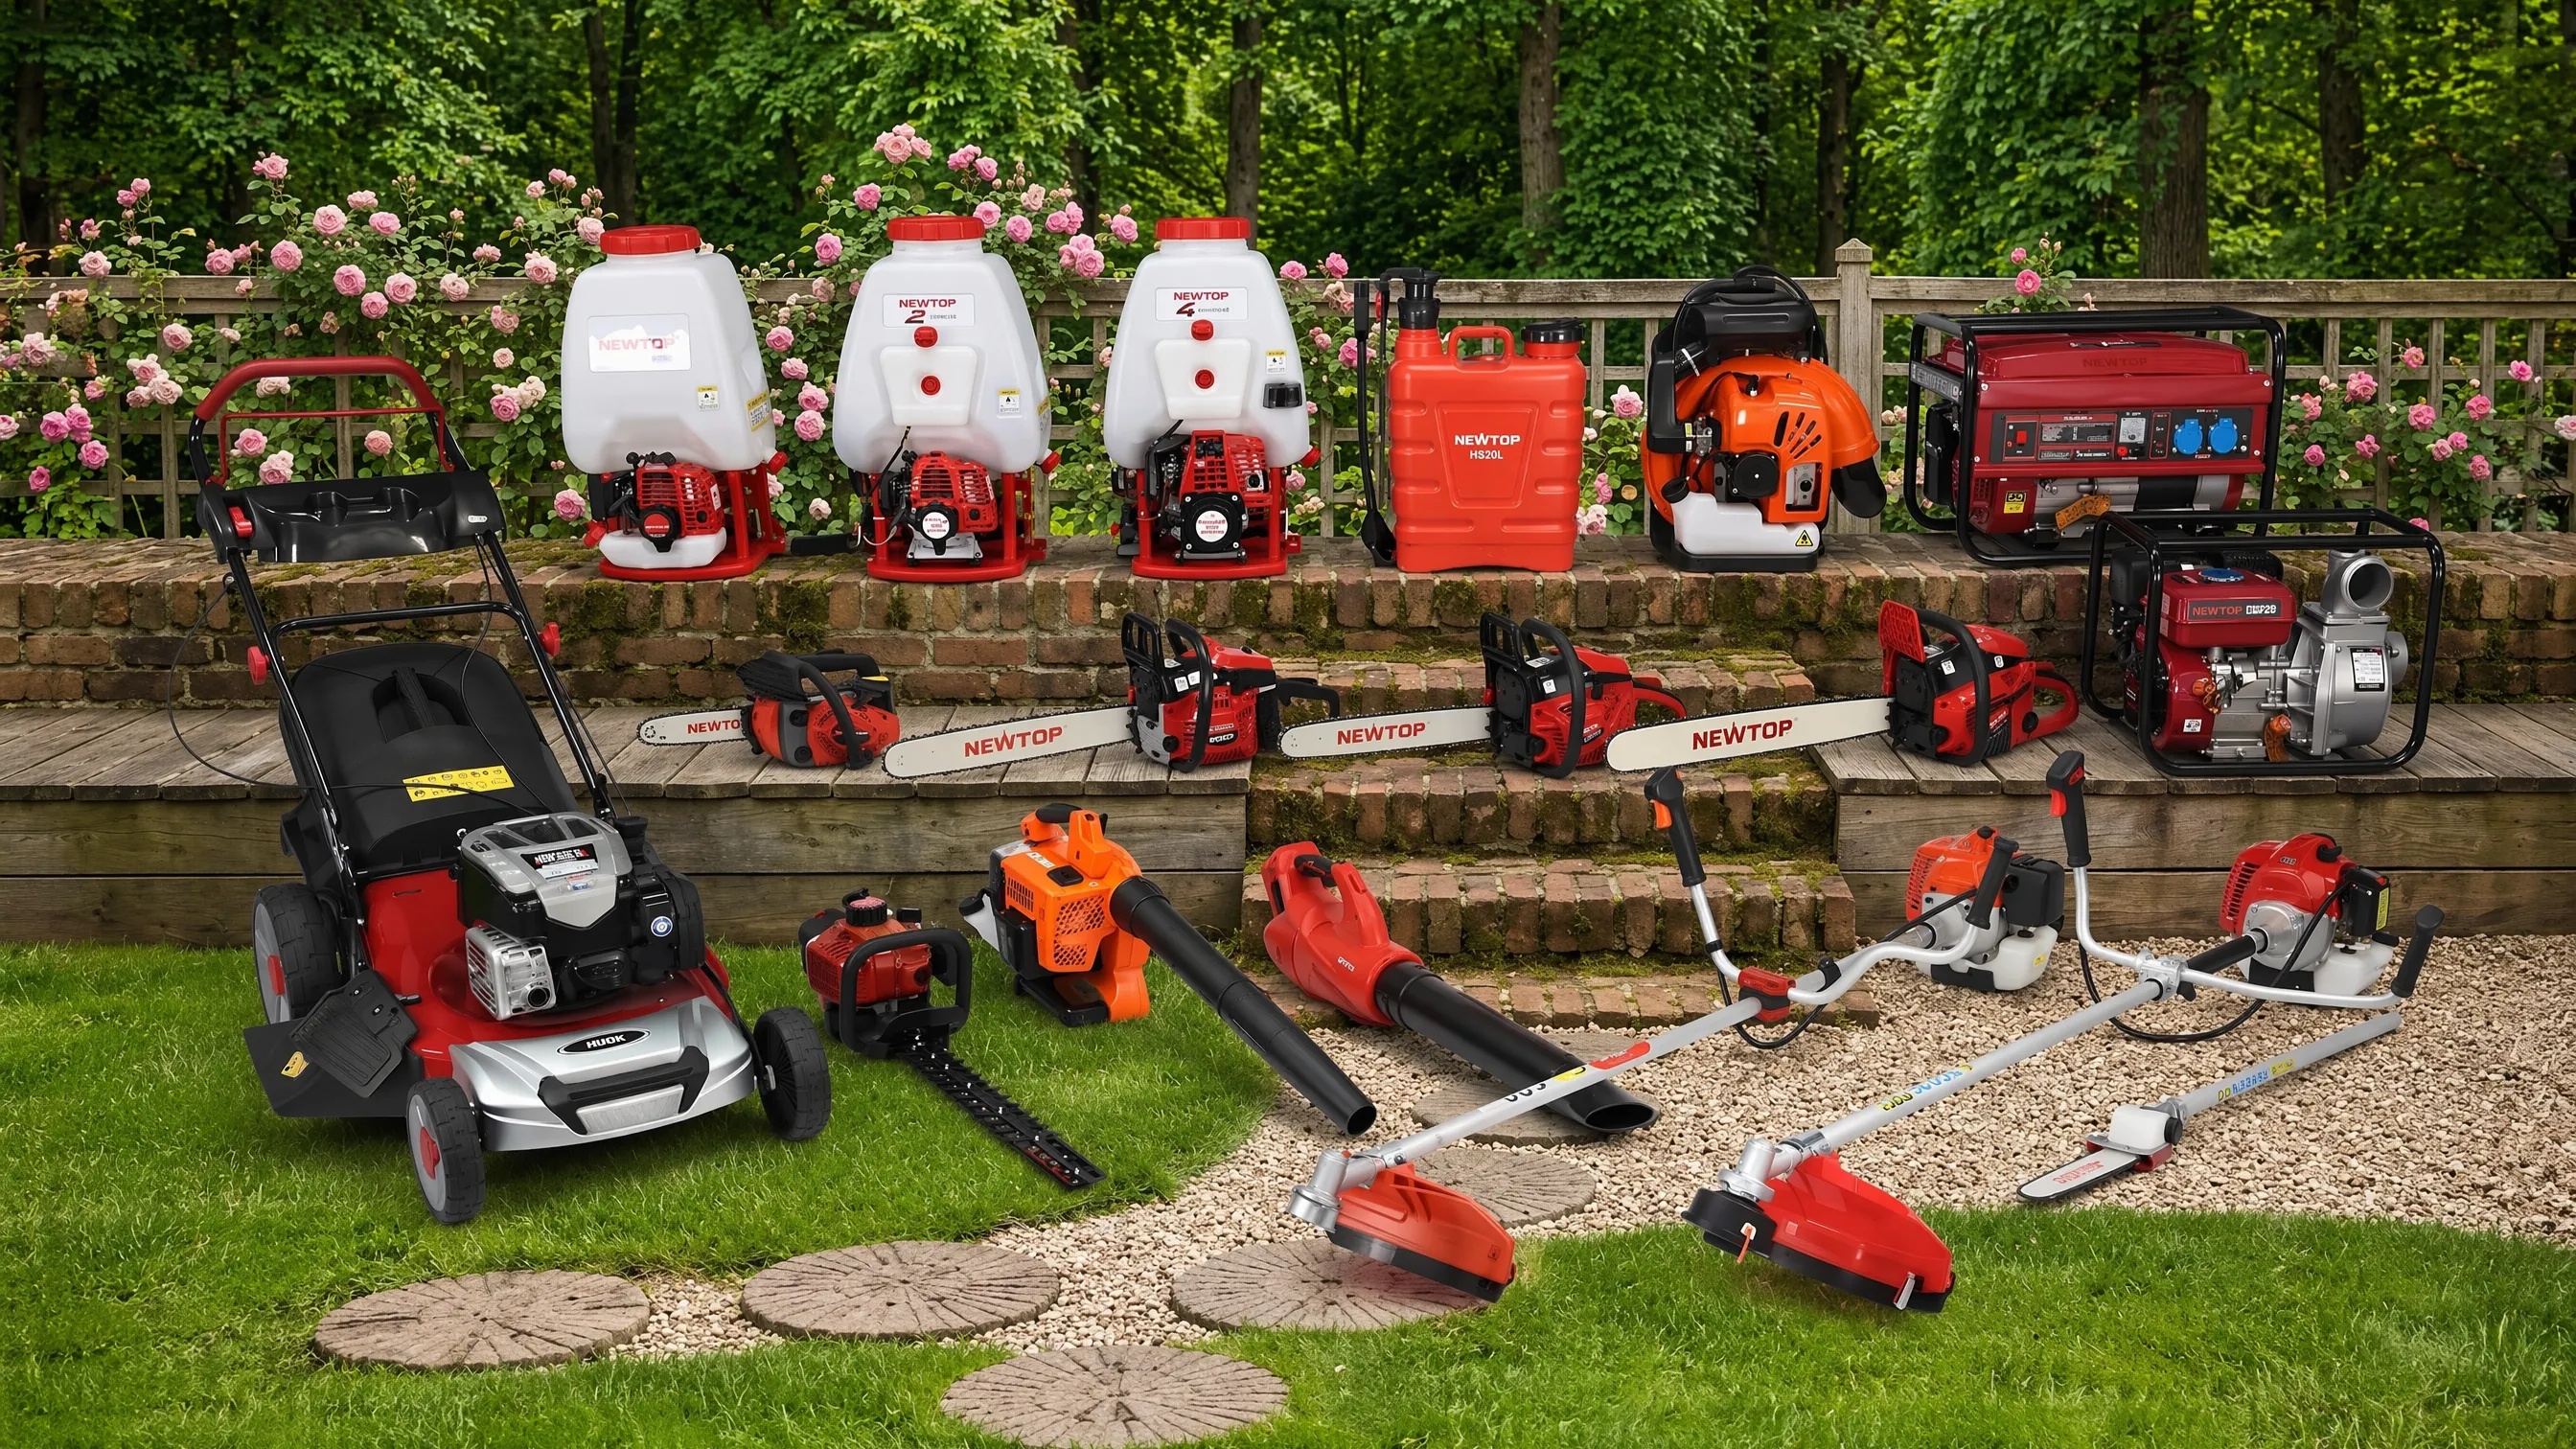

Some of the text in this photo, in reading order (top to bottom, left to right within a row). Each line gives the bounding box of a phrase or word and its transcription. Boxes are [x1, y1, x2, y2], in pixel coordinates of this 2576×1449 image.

[1174, 291, 1230, 301] NEWTOP
[899, 299, 956, 309] NEWTOP
[1175, 302, 1196, 317] 4
[904, 310, 927, 324] 2
[598, 338, 676, 351] NEWTOP
[1454, 432, 1521, 446] NEWTOP
[1469, 449, 1504, 460] HS20L
[2192, 606, 2242, 616] NEWTOP
[687, 719, 741, 734] NEWTO
[1337, 722, 1426, 745] NEWTOP
[964, 725, 1063, 757] NEWTOP
[1692, 719, 1793, 750] NEWTOP
[586, 1034, 627, 1049] HUOK
